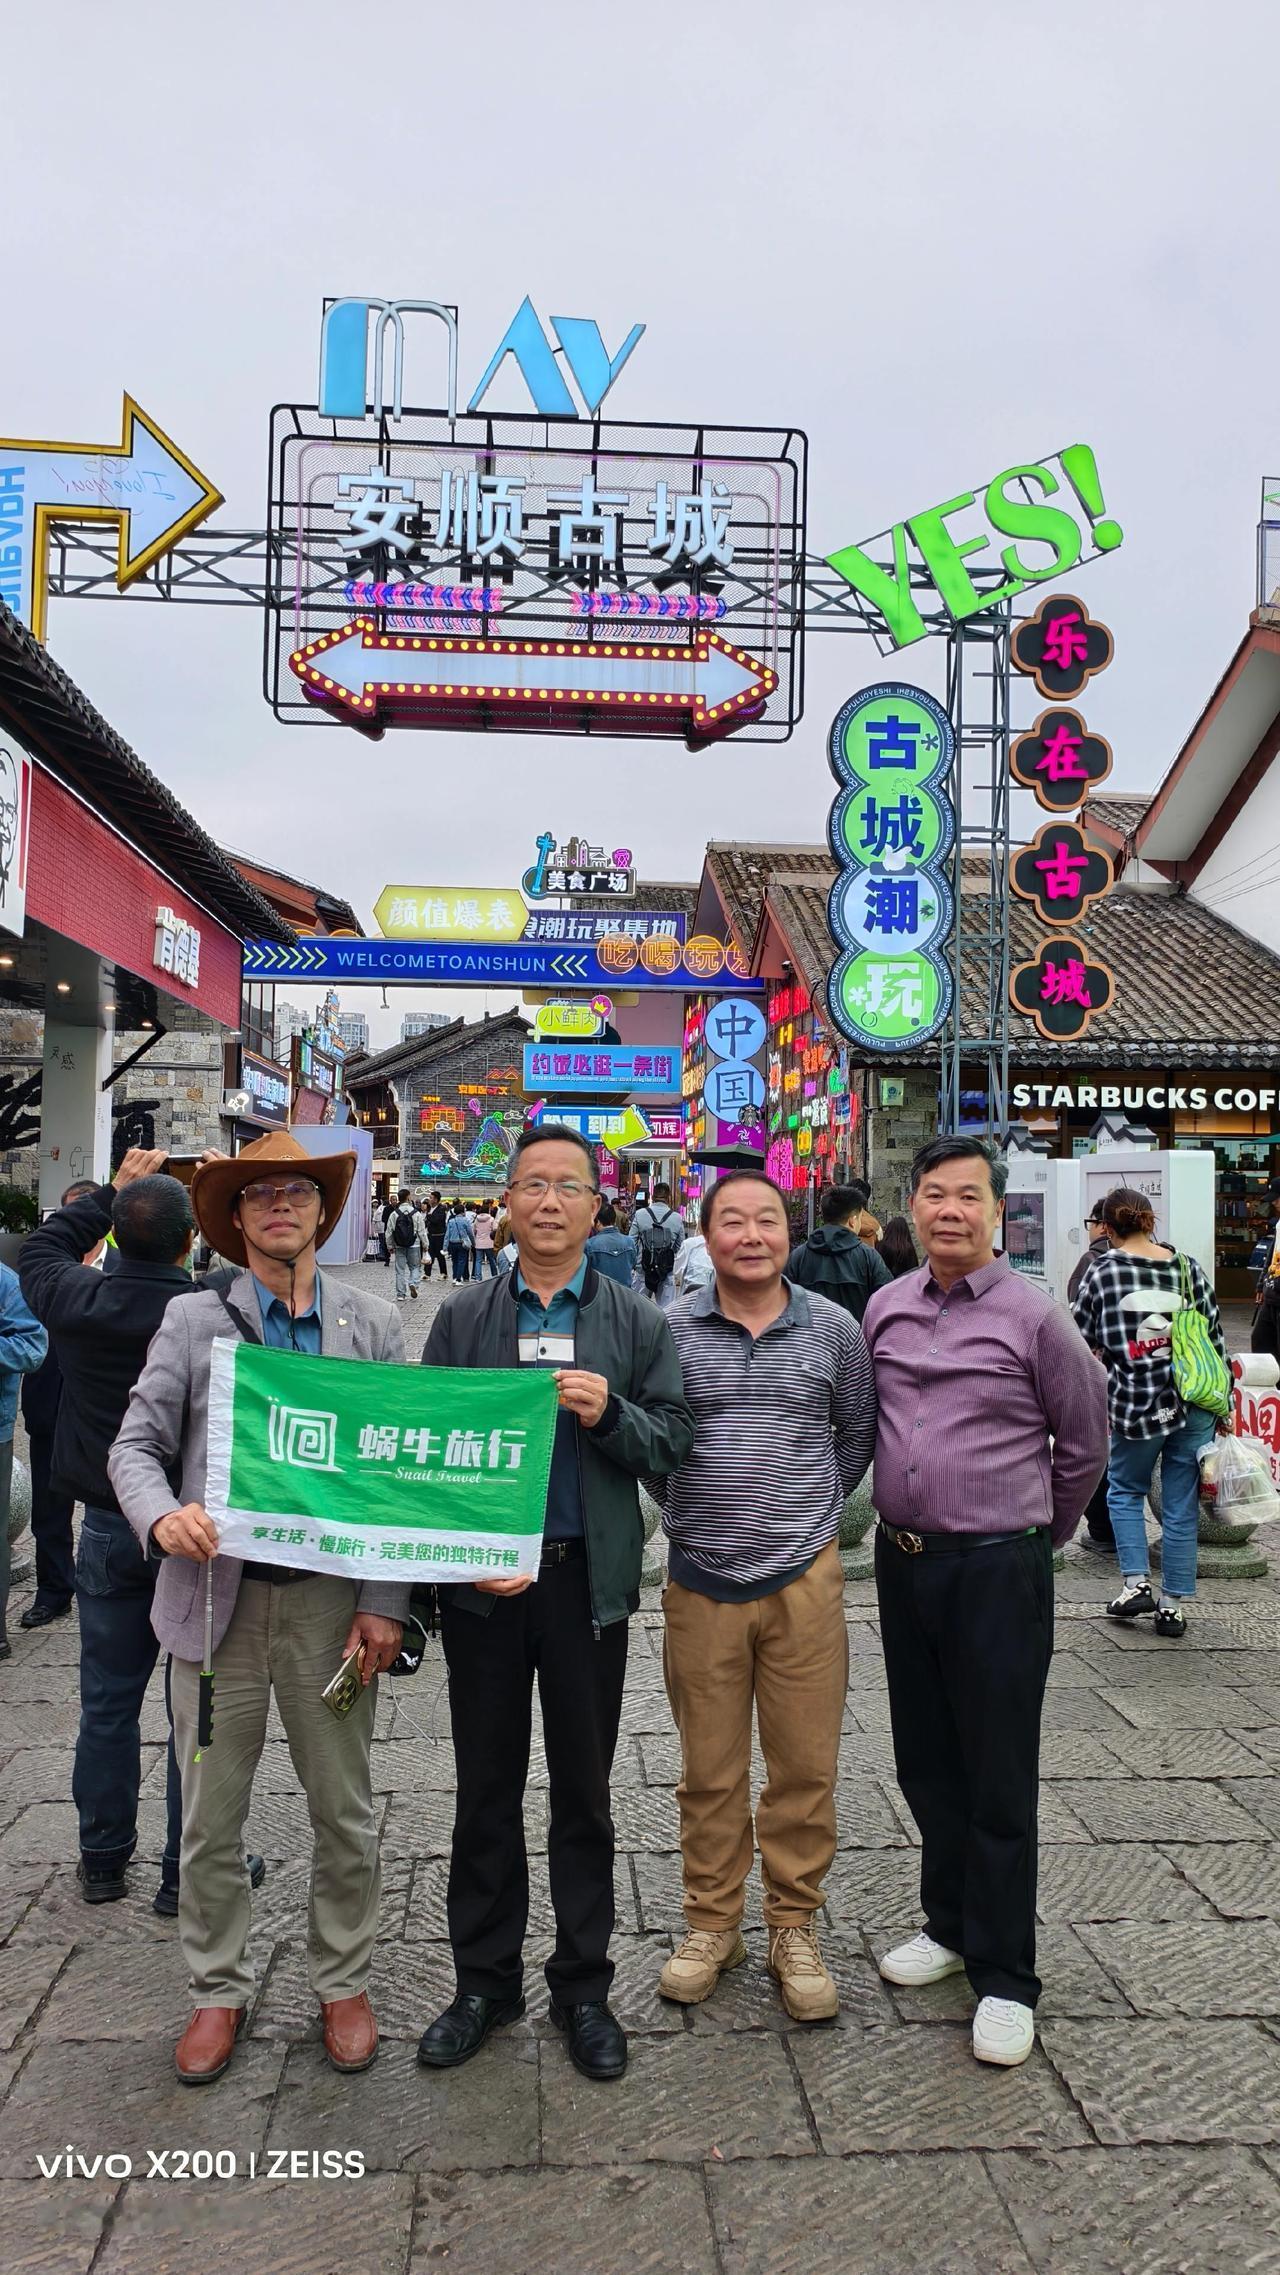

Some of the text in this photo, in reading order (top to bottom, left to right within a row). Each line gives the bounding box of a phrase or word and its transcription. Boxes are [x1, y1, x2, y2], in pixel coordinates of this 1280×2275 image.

[334, 466, 734, 568] 安顺古城
[824, 443, 1123, 647] YES!
[1035, 612, 1091, 1008] 乐在古城
[547, 871, 628, 892] 美食广场
[859, 715, 925, 1018] 古城潮玩
[387, 897, 516, 931] 颜值爆表
[153, 906, 201, 990] 肯德基
[337, 952, 546, 972] WELCOMETOANSHUN
[543, 1009, 597, 1028] 小鲜肉
[532, 1053, 673, 1083] 约饭必逛一条街
[714, 1004, 757, 1113] 中国
[1013, 1084, 1280, 1111] STARBUCKS COF
[357, 1423, 527, 1469] 蜗牛旅行
[395, 1466, 482, 1485] Snail Travel
